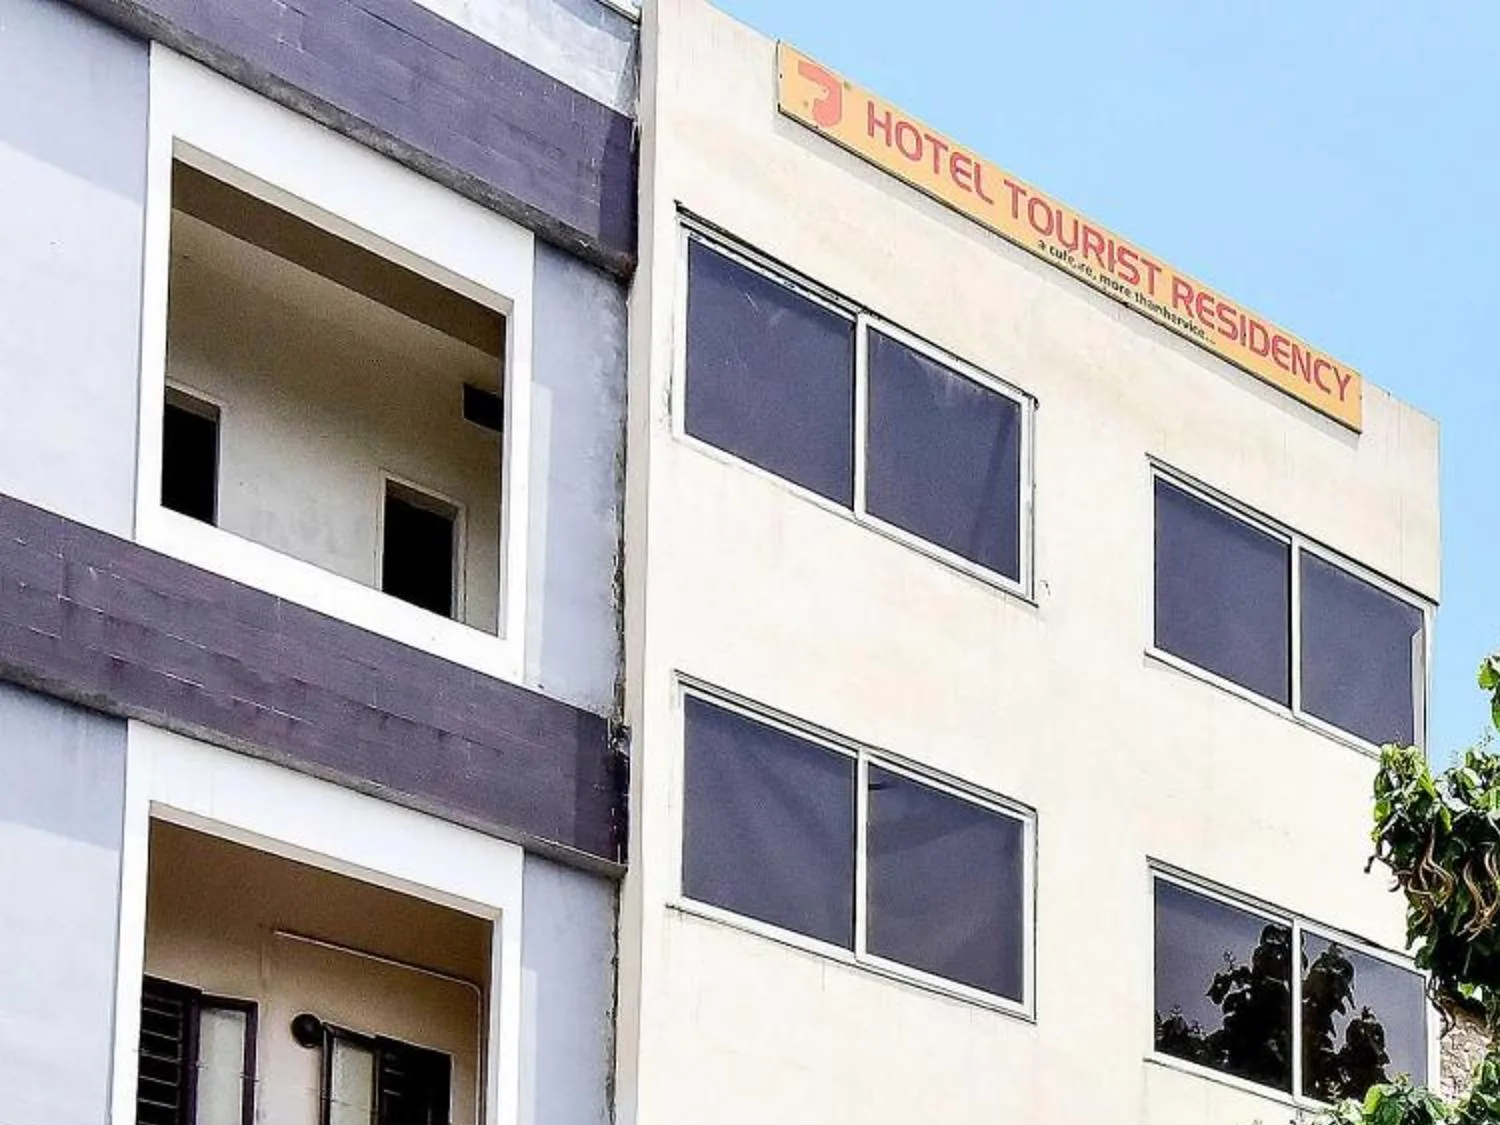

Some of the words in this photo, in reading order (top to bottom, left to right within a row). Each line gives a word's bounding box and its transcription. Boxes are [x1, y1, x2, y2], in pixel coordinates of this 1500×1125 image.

[867, 100, 993, 205] HOTEL
[1003, 179, 1162, 295] TOURIST
[1172, 275, 1352, 402] RESIDENCY
